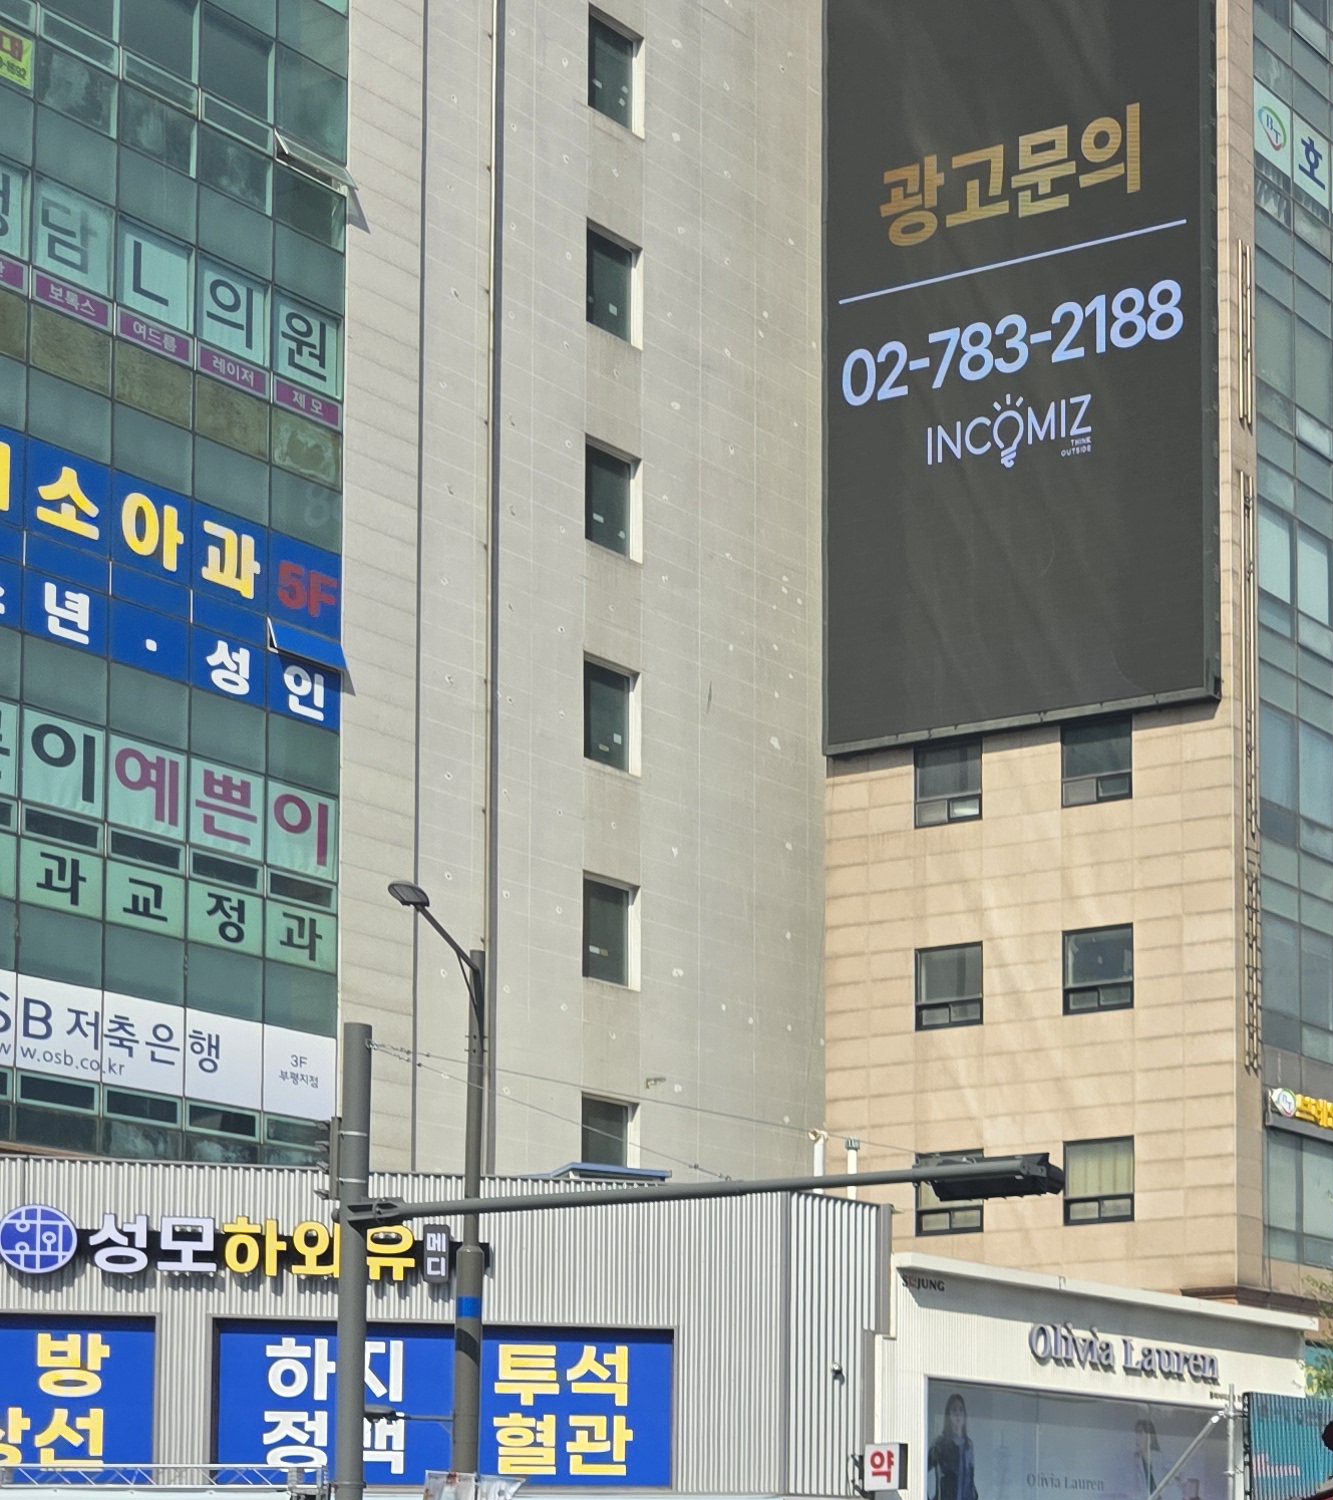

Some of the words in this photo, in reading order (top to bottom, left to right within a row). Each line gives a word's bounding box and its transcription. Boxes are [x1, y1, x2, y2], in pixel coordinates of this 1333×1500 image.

[880, 102, 1142, 247] 광고문의
[49, 283, 96, 318] 보톡스
[132, 320, 178, 354] 여드름
[841, 280, 1184, 407] 02-783-2188
[212, 354, 255, 387] 레이저
[277, 560, 339, 618] 5F
[206, 640, 325, 722] 성인
[66, 1008, 221, 1074] 저축은행
[290, 1053, 308, 1069] 3F
[279, 1070, 319, 1090] 부평지점
[493, 1344, 629, 1408] 투석
[1029, 1321, 1115, 1370] Olivia
[1122, 1337, 1220, 1382] Lauren
[493, 1412, 634, 1477] 혈관
[869, 1449, 895, 1483] 약
[1027, 1473, 1062, 1490] Olivia
[1064, 1476, 1105, 1492] Lauren
